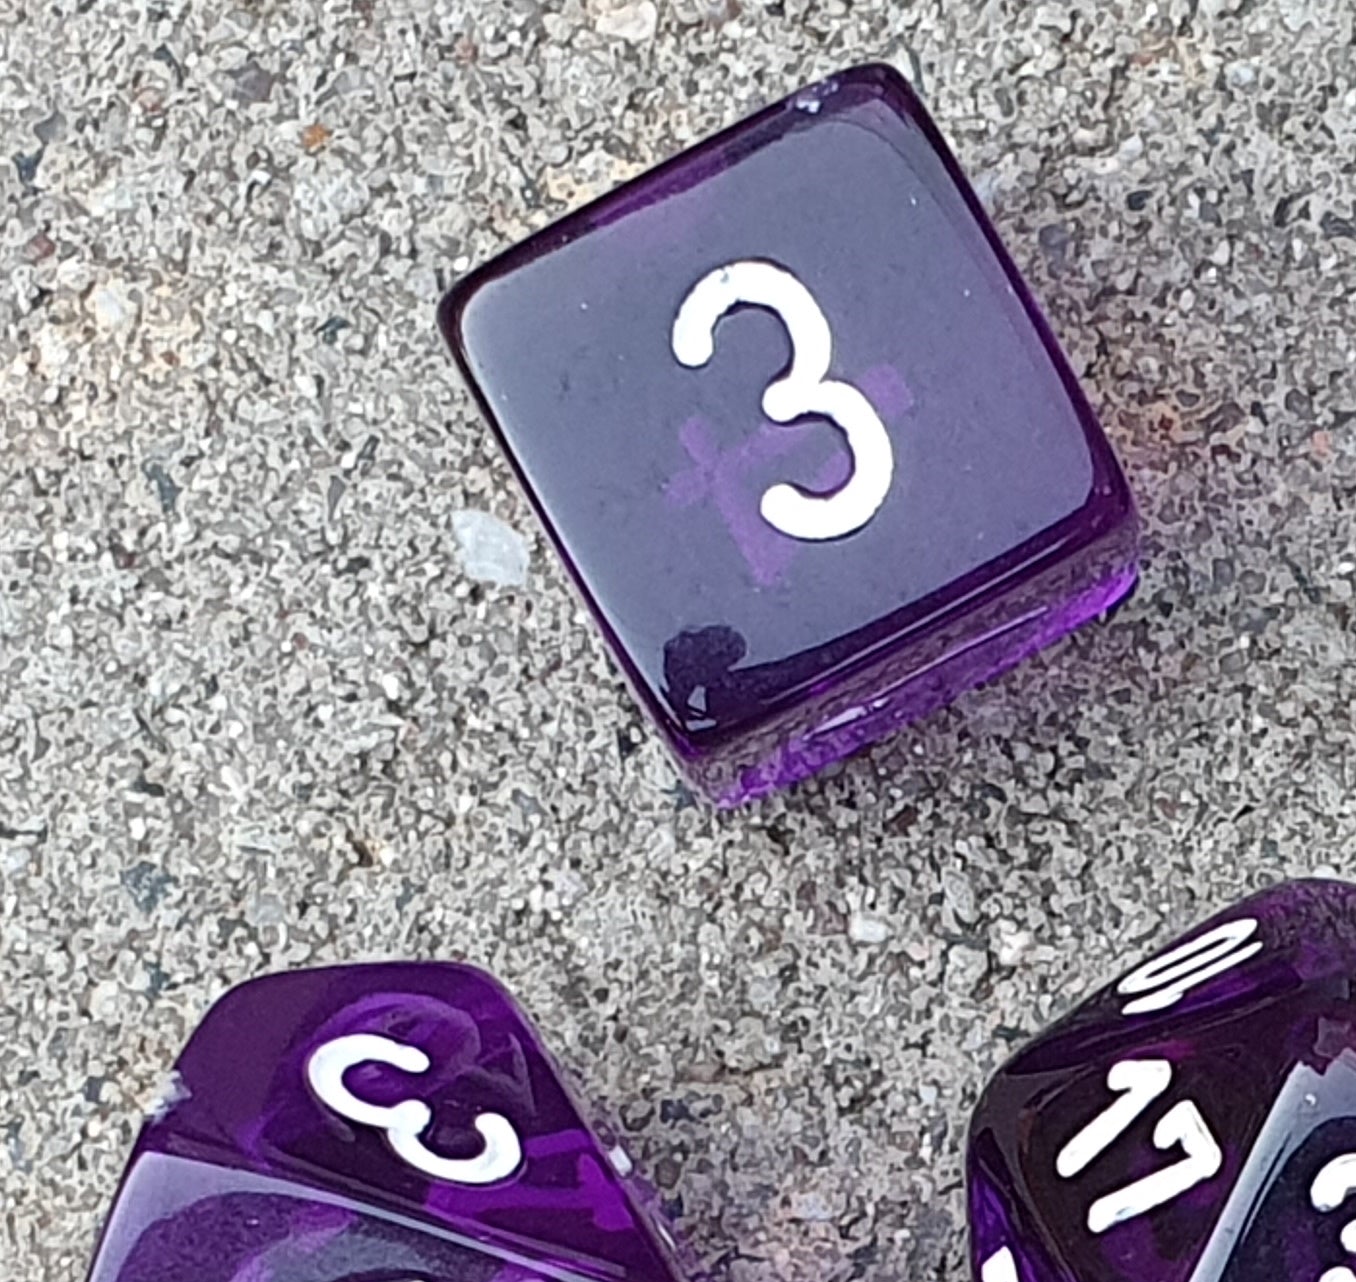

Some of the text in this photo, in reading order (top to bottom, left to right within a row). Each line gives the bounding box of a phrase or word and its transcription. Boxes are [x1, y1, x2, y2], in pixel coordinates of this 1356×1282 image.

[672, 258, 894, 541] 3
[308, 1034, 521, 1183] 3
[1057, 1059, 1222, 1233] 17
